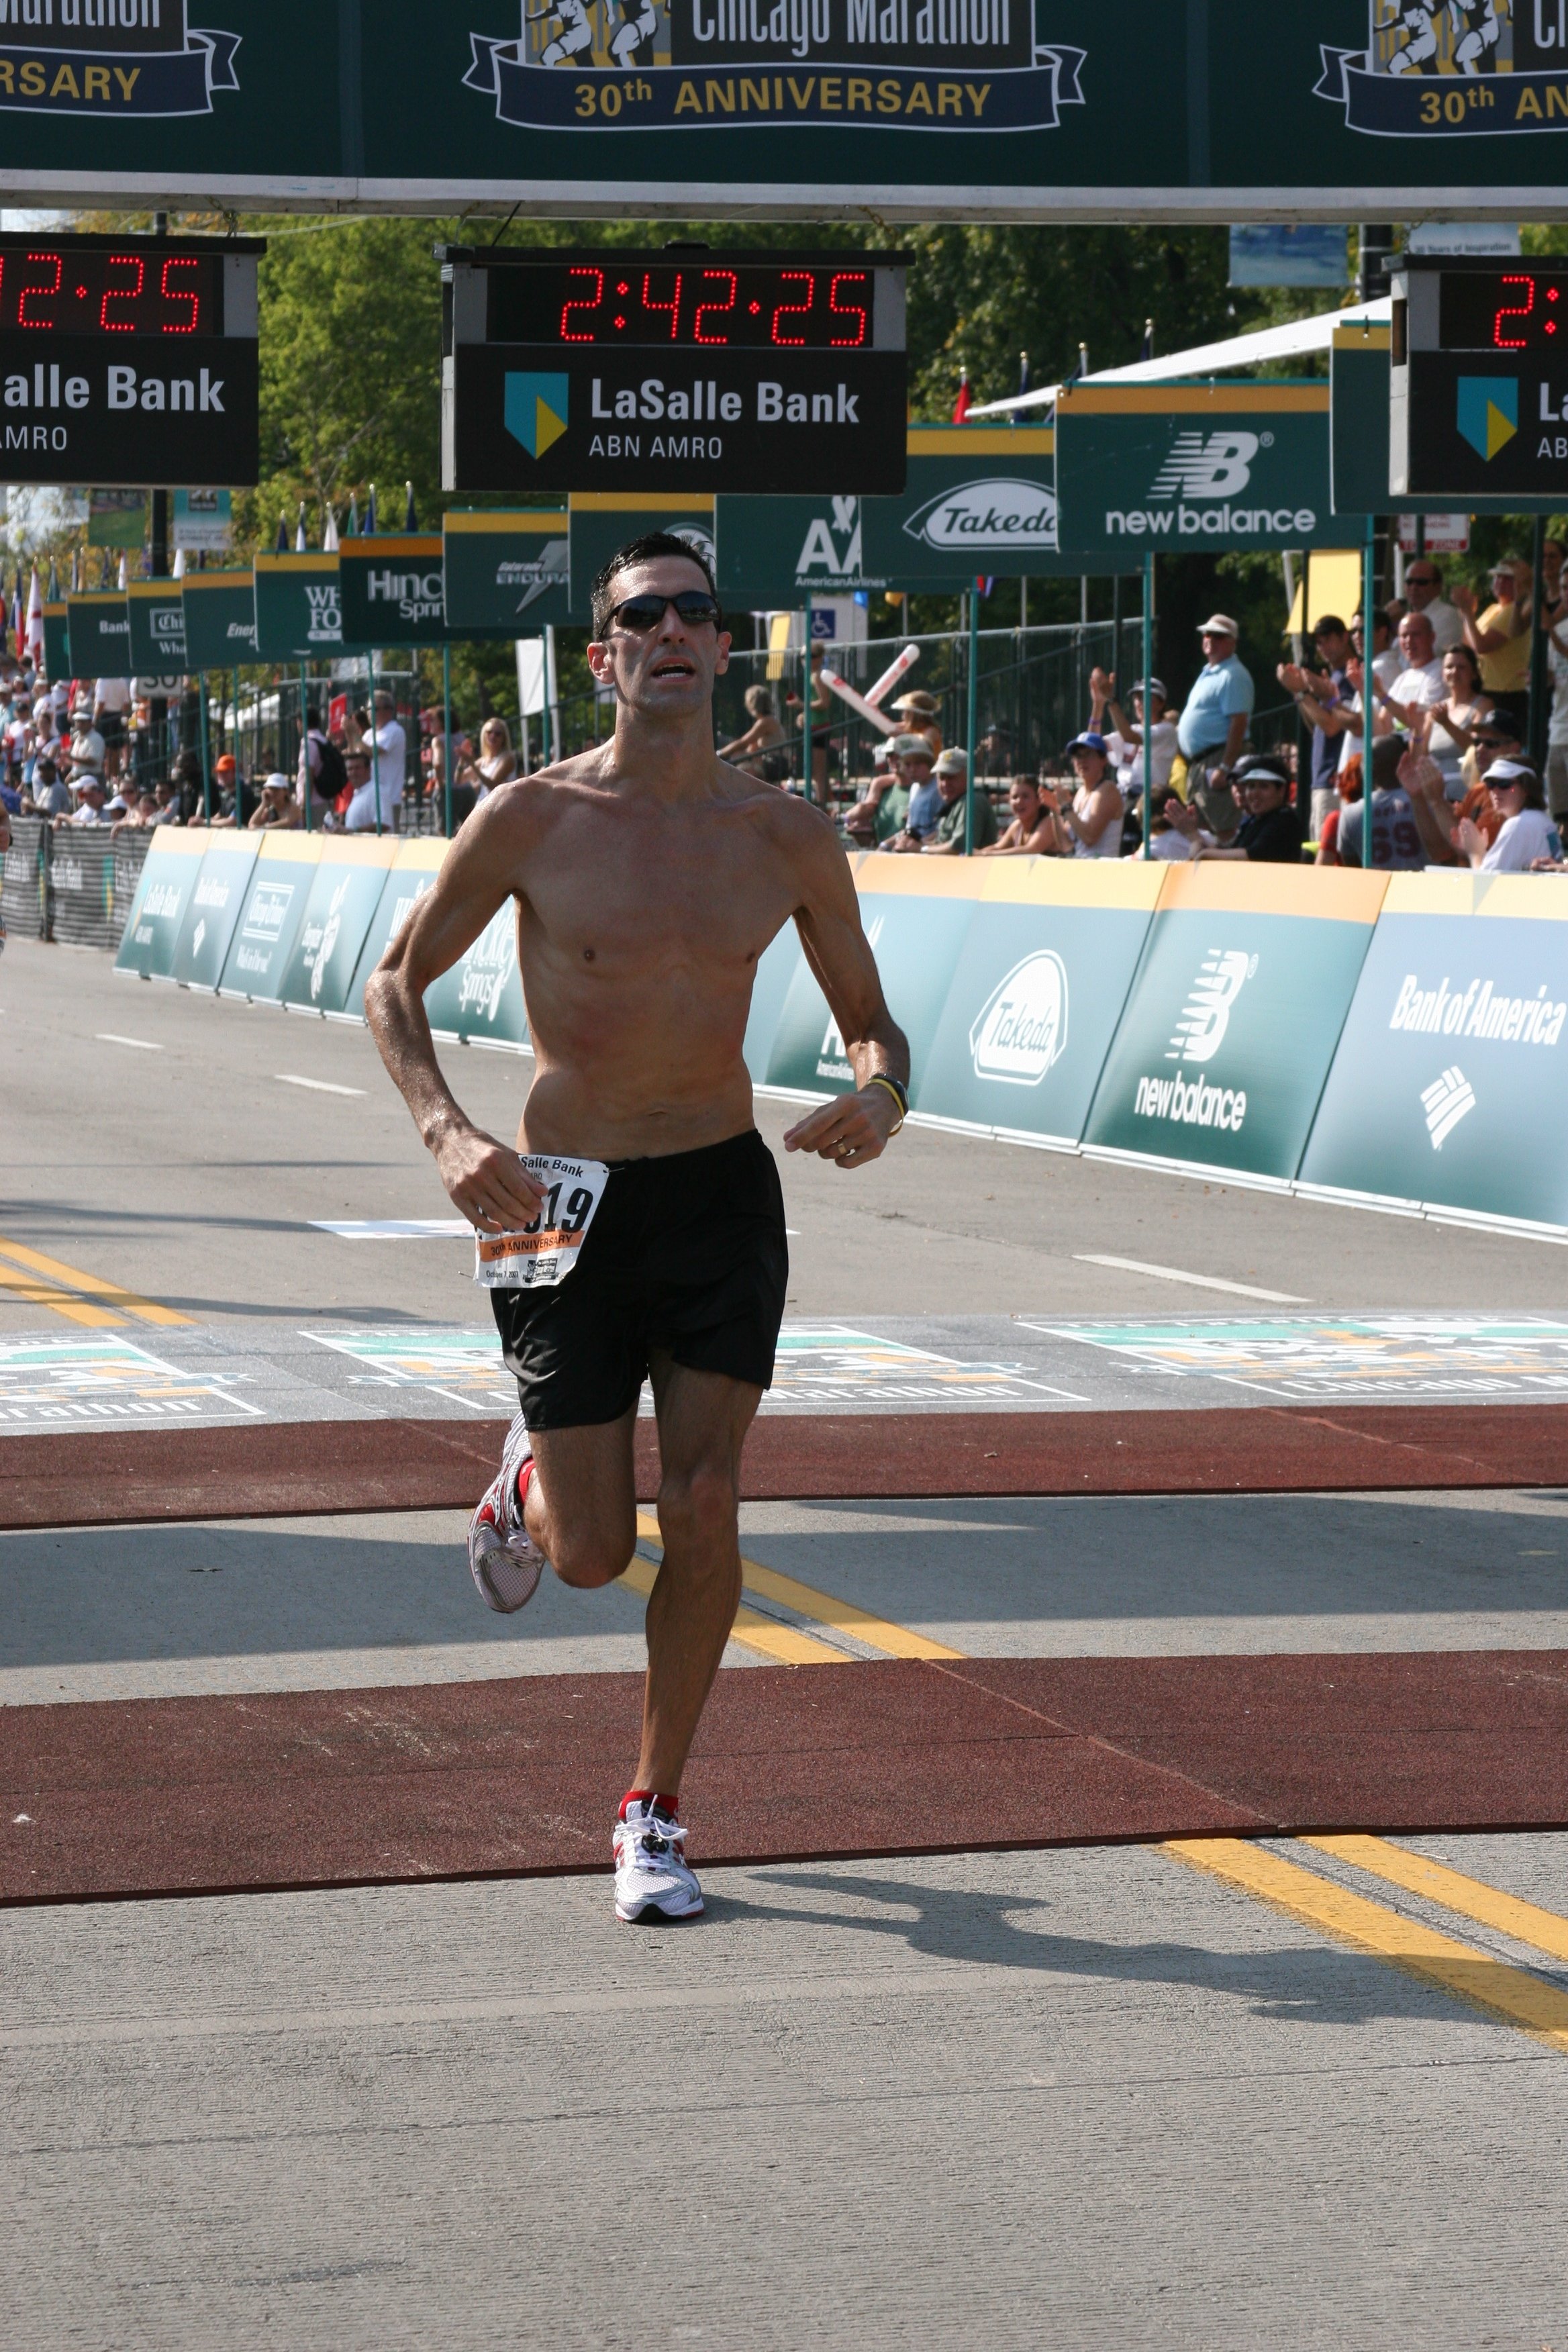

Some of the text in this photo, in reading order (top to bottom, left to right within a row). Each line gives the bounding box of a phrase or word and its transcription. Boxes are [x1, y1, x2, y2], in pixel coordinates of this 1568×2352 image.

[575, 77, 991, 117] 30th ANNIVERSARY
[1420, 85, 1495, 124] 30th
[107, 365, 225, 412] Bank
[591, 378, 860, 423] LaSalle Bank
[0, 426, 67, 450] MRO
[589, 434, 722, 458] ABN AMRO
[989, 1001, 1055, 1053] Takeda
[1389, 975, 1451, 1034] Bank
[1463, 980, 1567, 1046] America
[552, 1159, 584, 1178] Bank
[507, 1234, 573, 1253] ANNIVERSARY
